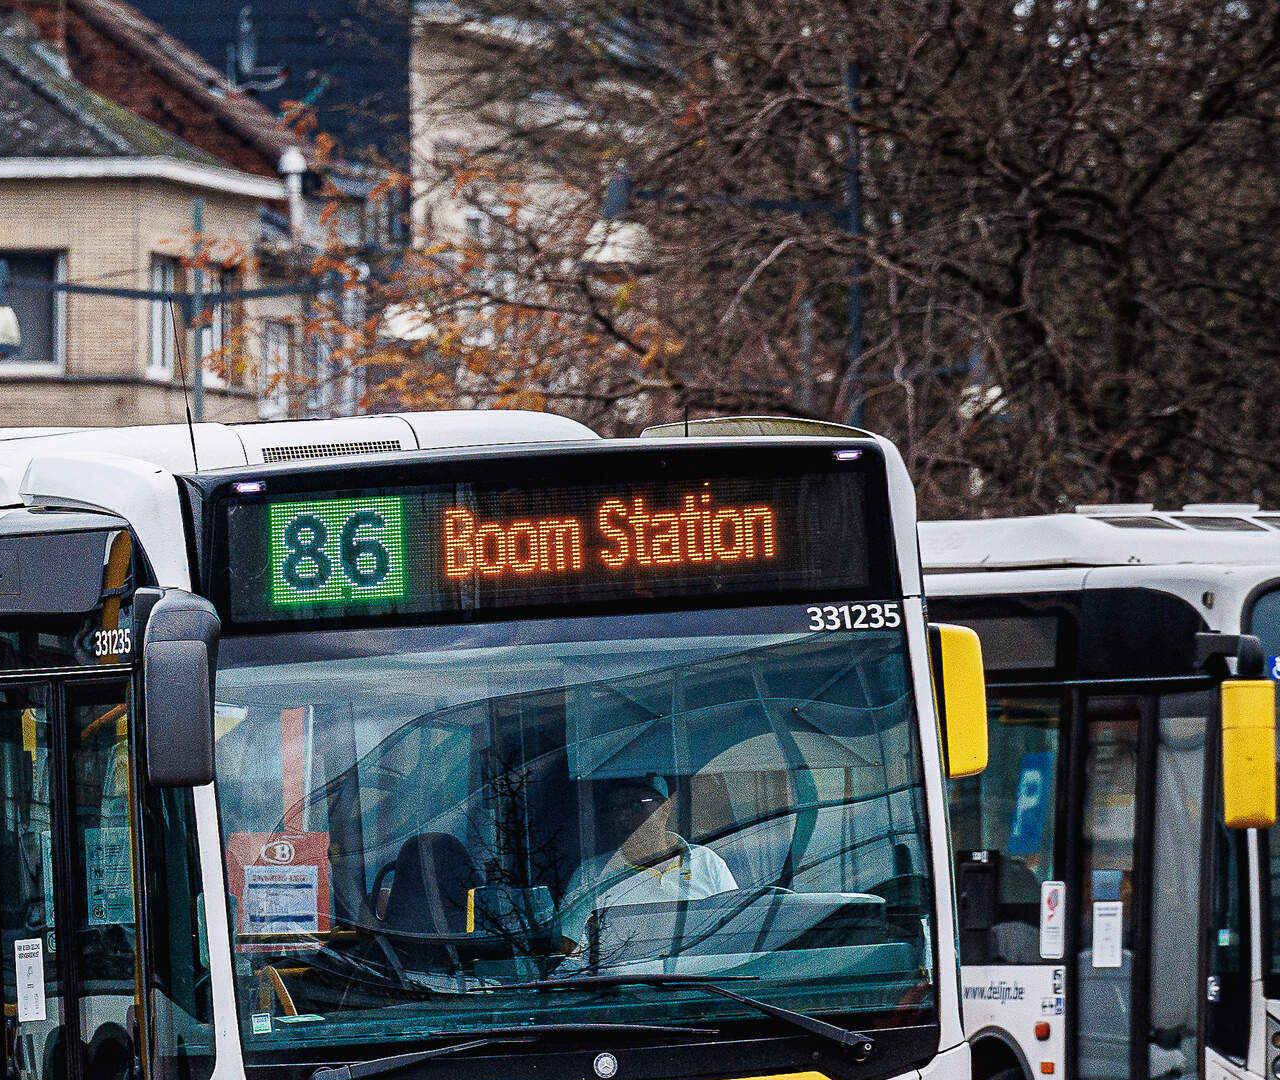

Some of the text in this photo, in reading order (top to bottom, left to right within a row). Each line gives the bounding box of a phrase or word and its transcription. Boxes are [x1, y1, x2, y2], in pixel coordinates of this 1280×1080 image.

[282, 490, 775, 592] 86 Boom Station
[806, 603, 901, 631] 331235
[95, 628, 131, 656] 331235
